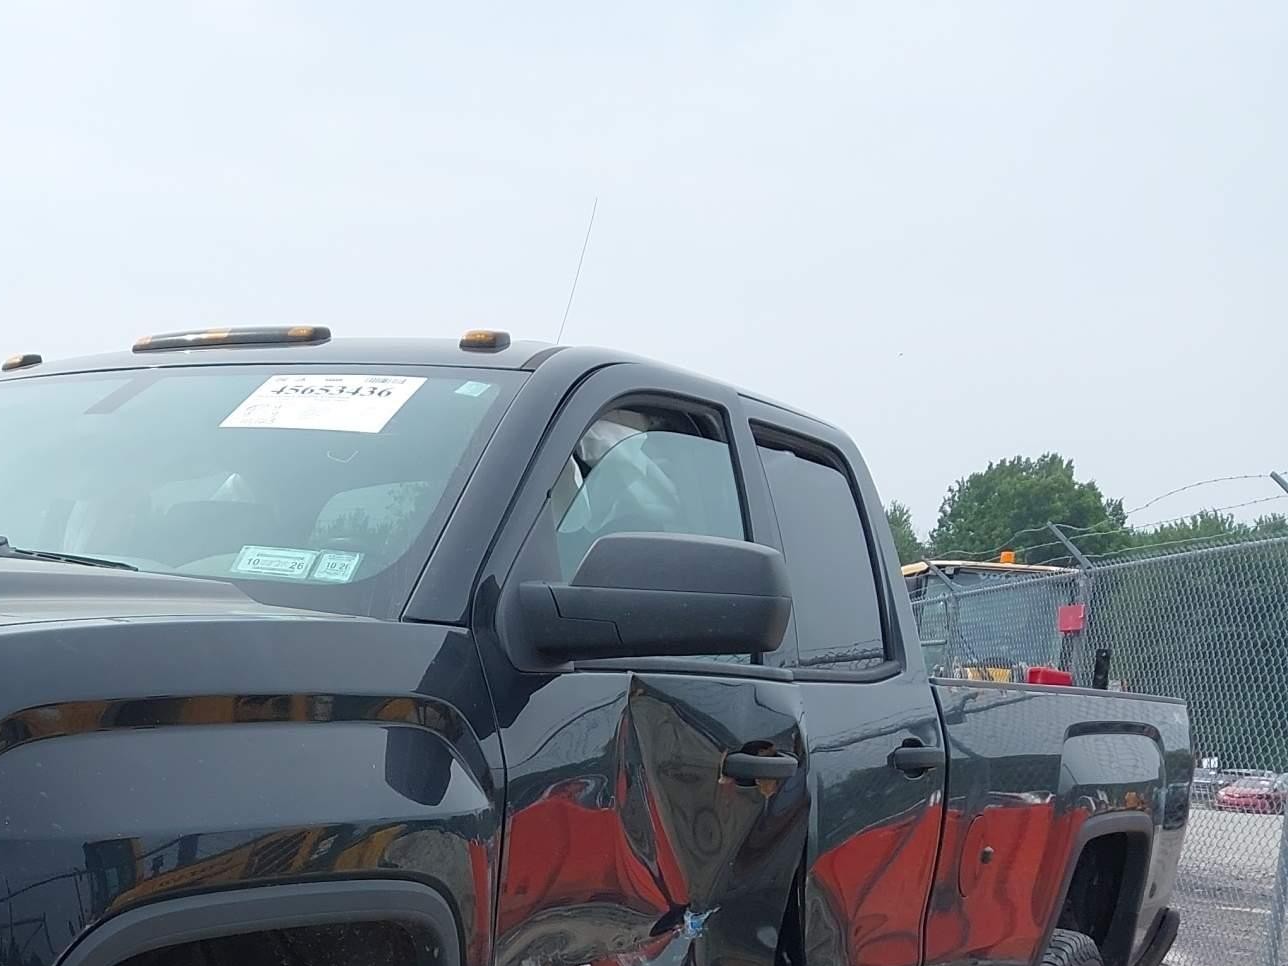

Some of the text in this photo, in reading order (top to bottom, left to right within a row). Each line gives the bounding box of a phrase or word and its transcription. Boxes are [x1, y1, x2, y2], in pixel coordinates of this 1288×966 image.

[271, 385, 393, 398] 45653436
[247, 558, 261, 566] 10
[289, 561, 305, 570] 26
